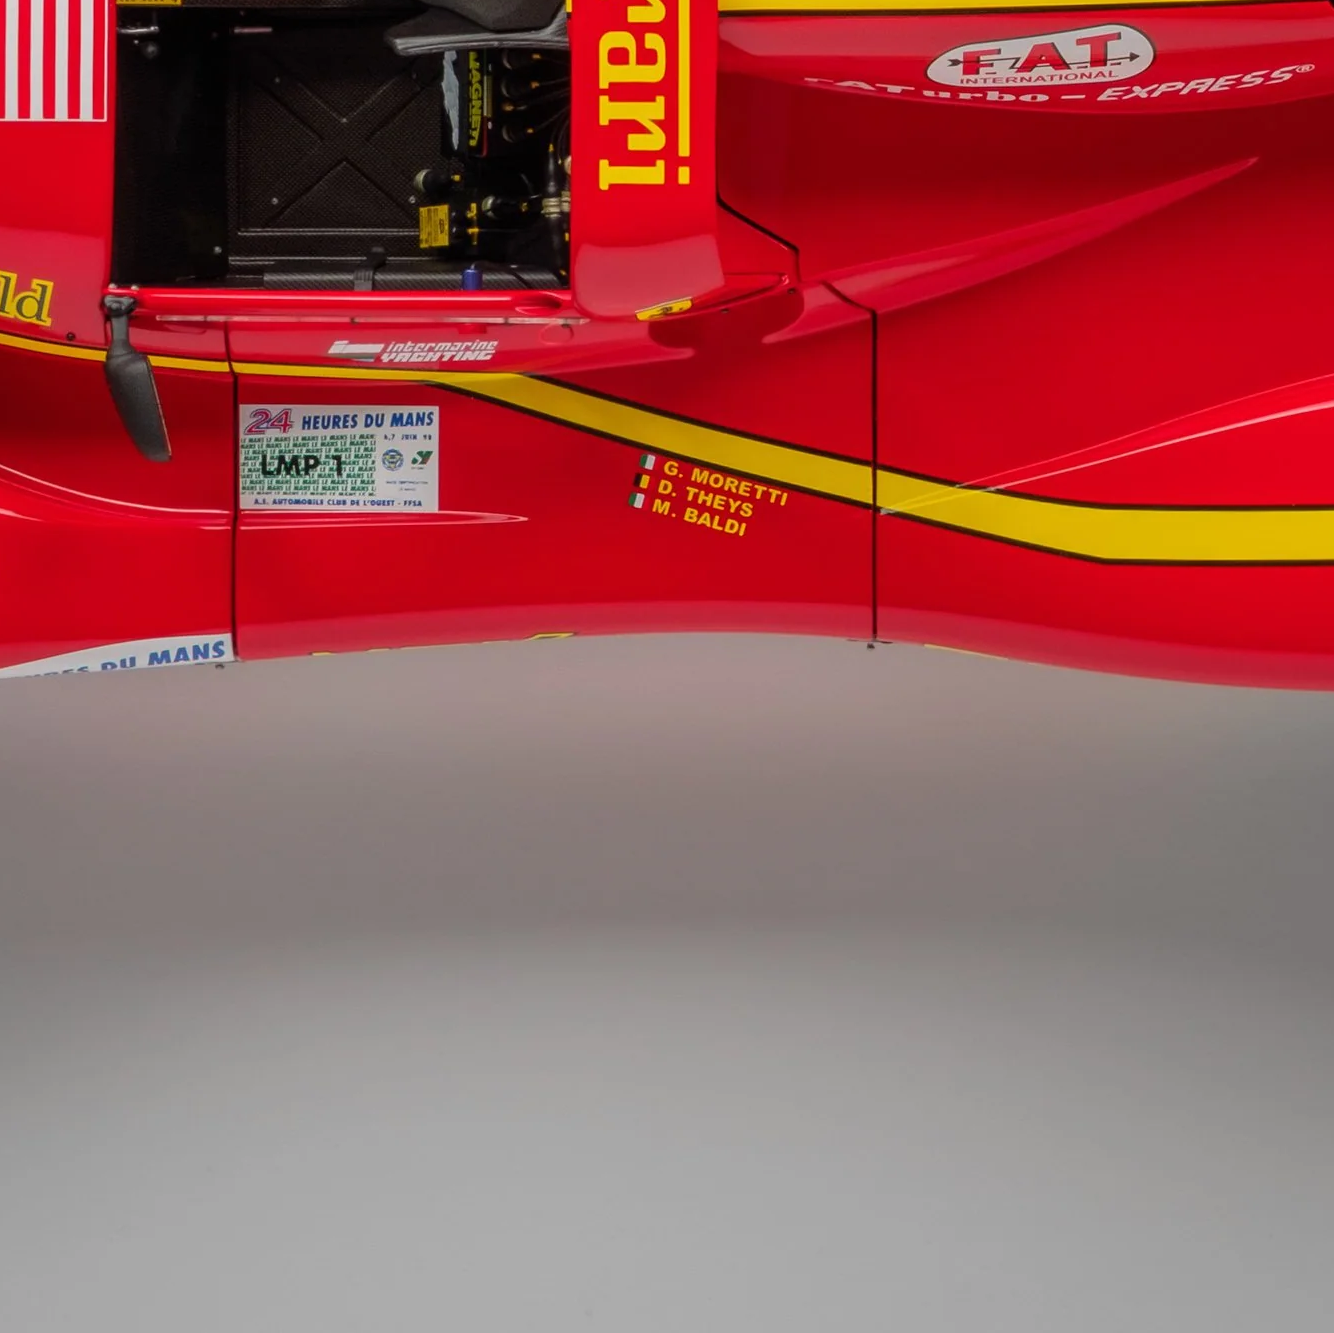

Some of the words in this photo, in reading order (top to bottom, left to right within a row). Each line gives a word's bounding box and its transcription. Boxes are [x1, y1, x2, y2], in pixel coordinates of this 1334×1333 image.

[960, 70, 1119, 84] INTERNATIONAL
[381, 351, 495, 362] YACHTING
[387, 340, 499, 352] intermarine
[244, 409, 294, 435] 24
[302, 414, 358, 430] HEURES
[364, 414, 384, 428] DU
[390, 411, 434, 427] MANS
[261, 454, 321, 476] LMP
[332, 454, 343, 477] 1
[664, 461, 683, 478] G.
[691, 468, 788, 506] MORETTI
[658, 479, 676, 497] D.
[686, 486, 753, 517] THEYS
[652, 499, 676, 517] M.
[684, 508, 747, 536] BALDI
[148, 641, 225, 665] MANS
